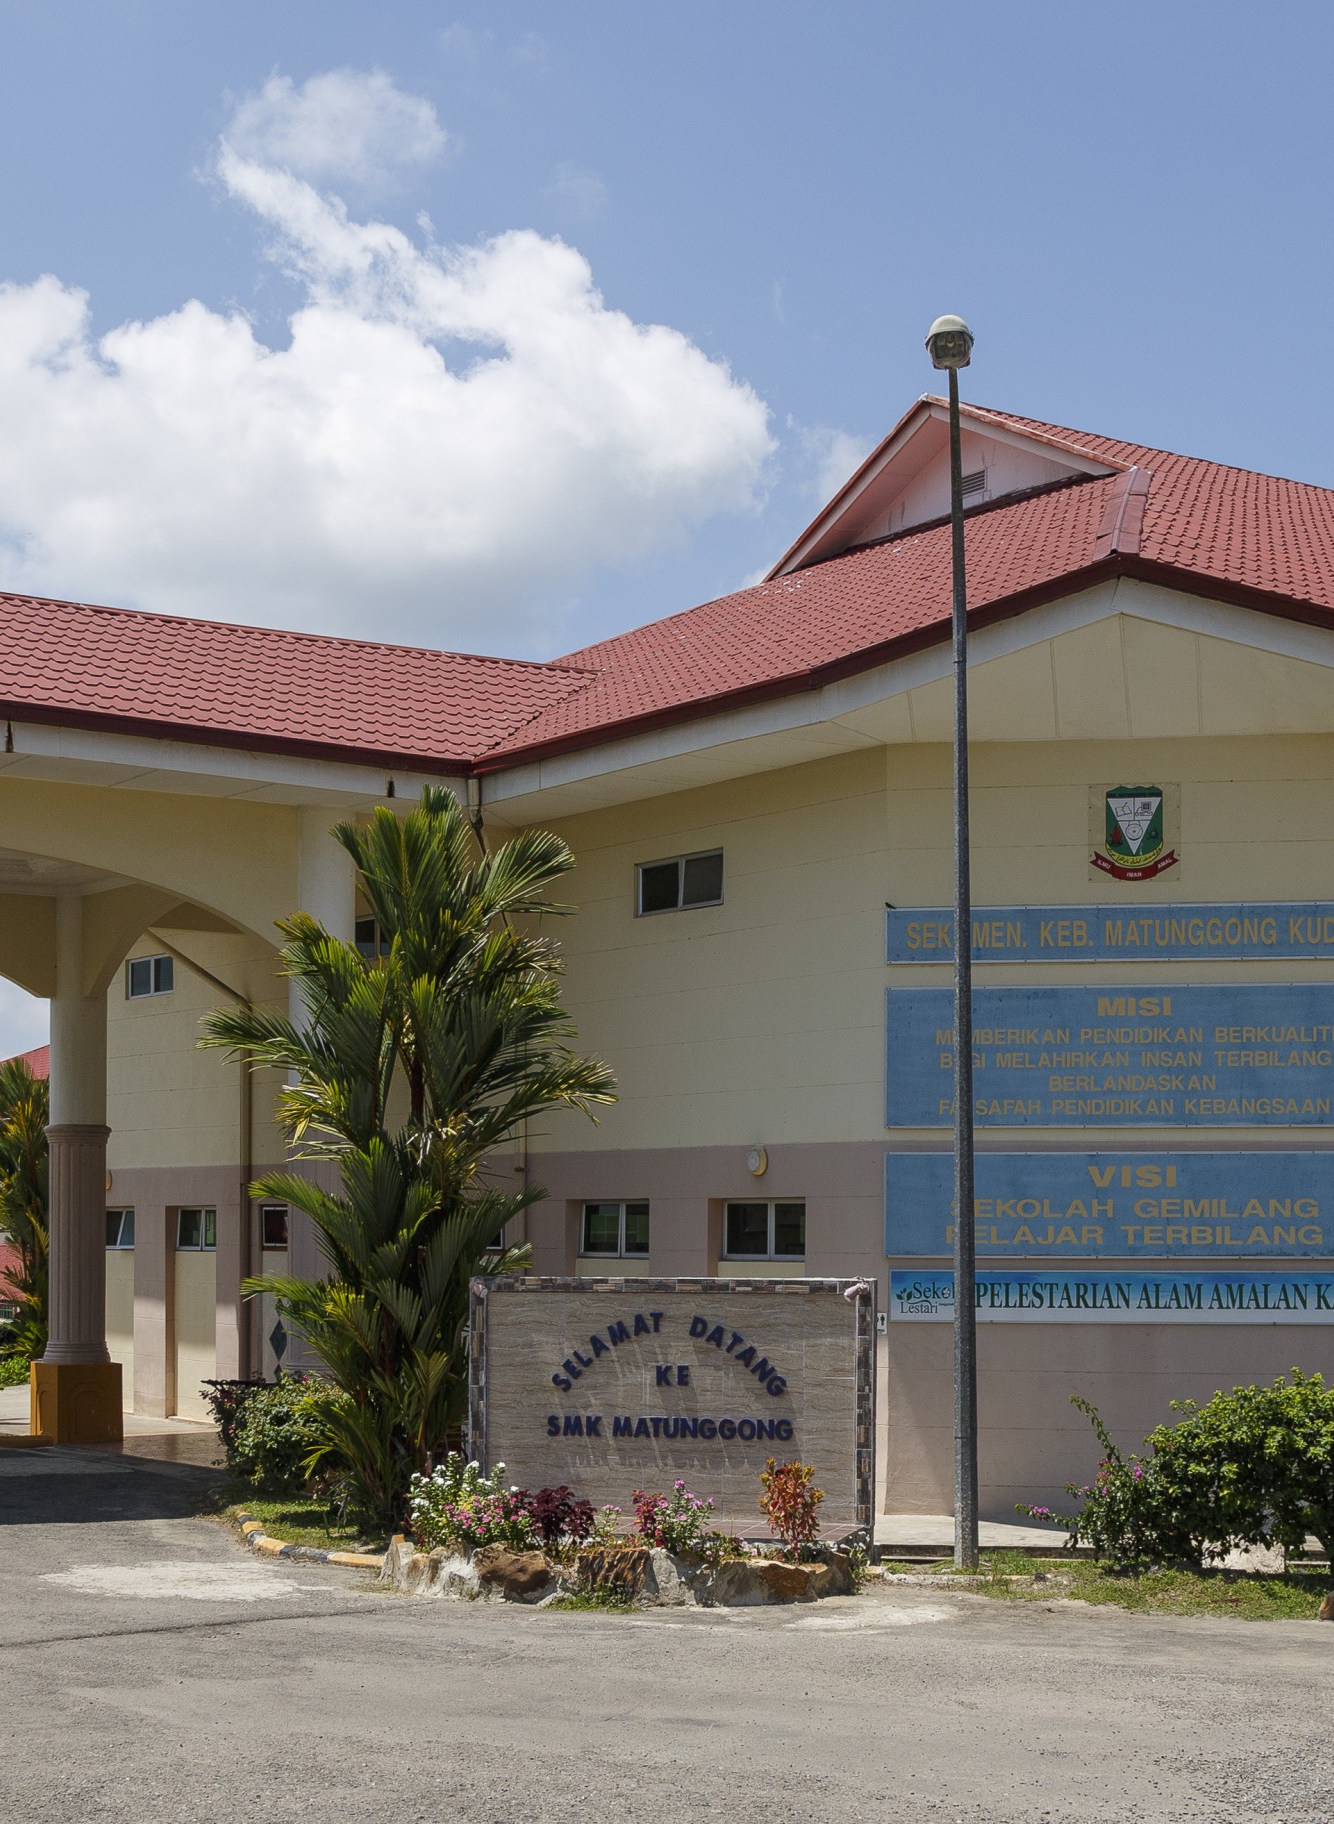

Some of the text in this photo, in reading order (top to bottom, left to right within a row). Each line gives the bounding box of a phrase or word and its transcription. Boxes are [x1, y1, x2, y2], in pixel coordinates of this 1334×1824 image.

[972, 921, 1028, 948] MEN.
[1040, 920, 1093, 948] KEB.
[1105, 917, 1277, 946] MATUNGGONG
[1097, 997, 1172, 1017] MISI
[936, 1028, 1070, 1045] MMBERIKAN
[1080, 1027, 1203, 1044] PENDIDIKAN
[940, 1050, 1332, 1069] BGI MELAHIRKAN INSAN TERBILANG
[1048, 1074, 1216, 1092] BERLANDASKAN
[1051, 1098, 1174, 1115] PENDIDIKAN
[1185, 1098, 1330, 1115] KEBANGSAAN
[1087, 1165, 1177, 1188] VISI
[950, 1198, 1320, 1218] EKOLAH GEMILANG
[1120, 1225, 1324, 1245] TERBILANG
[975, 1282, 1132, 1309] PELESTARIAN
[1136, 1282, 1203, 1310] ALAM
[1208, 1283, 1310, 1310] AMALAN
[900, 1301, 938, 1314] Lestari
[551, 1311, 787, 1398] SELAMAT DATANG
[655, 1364, 690, 1387] KE
[547, 1415, 794, 1441] SMK MATUNGGONG
